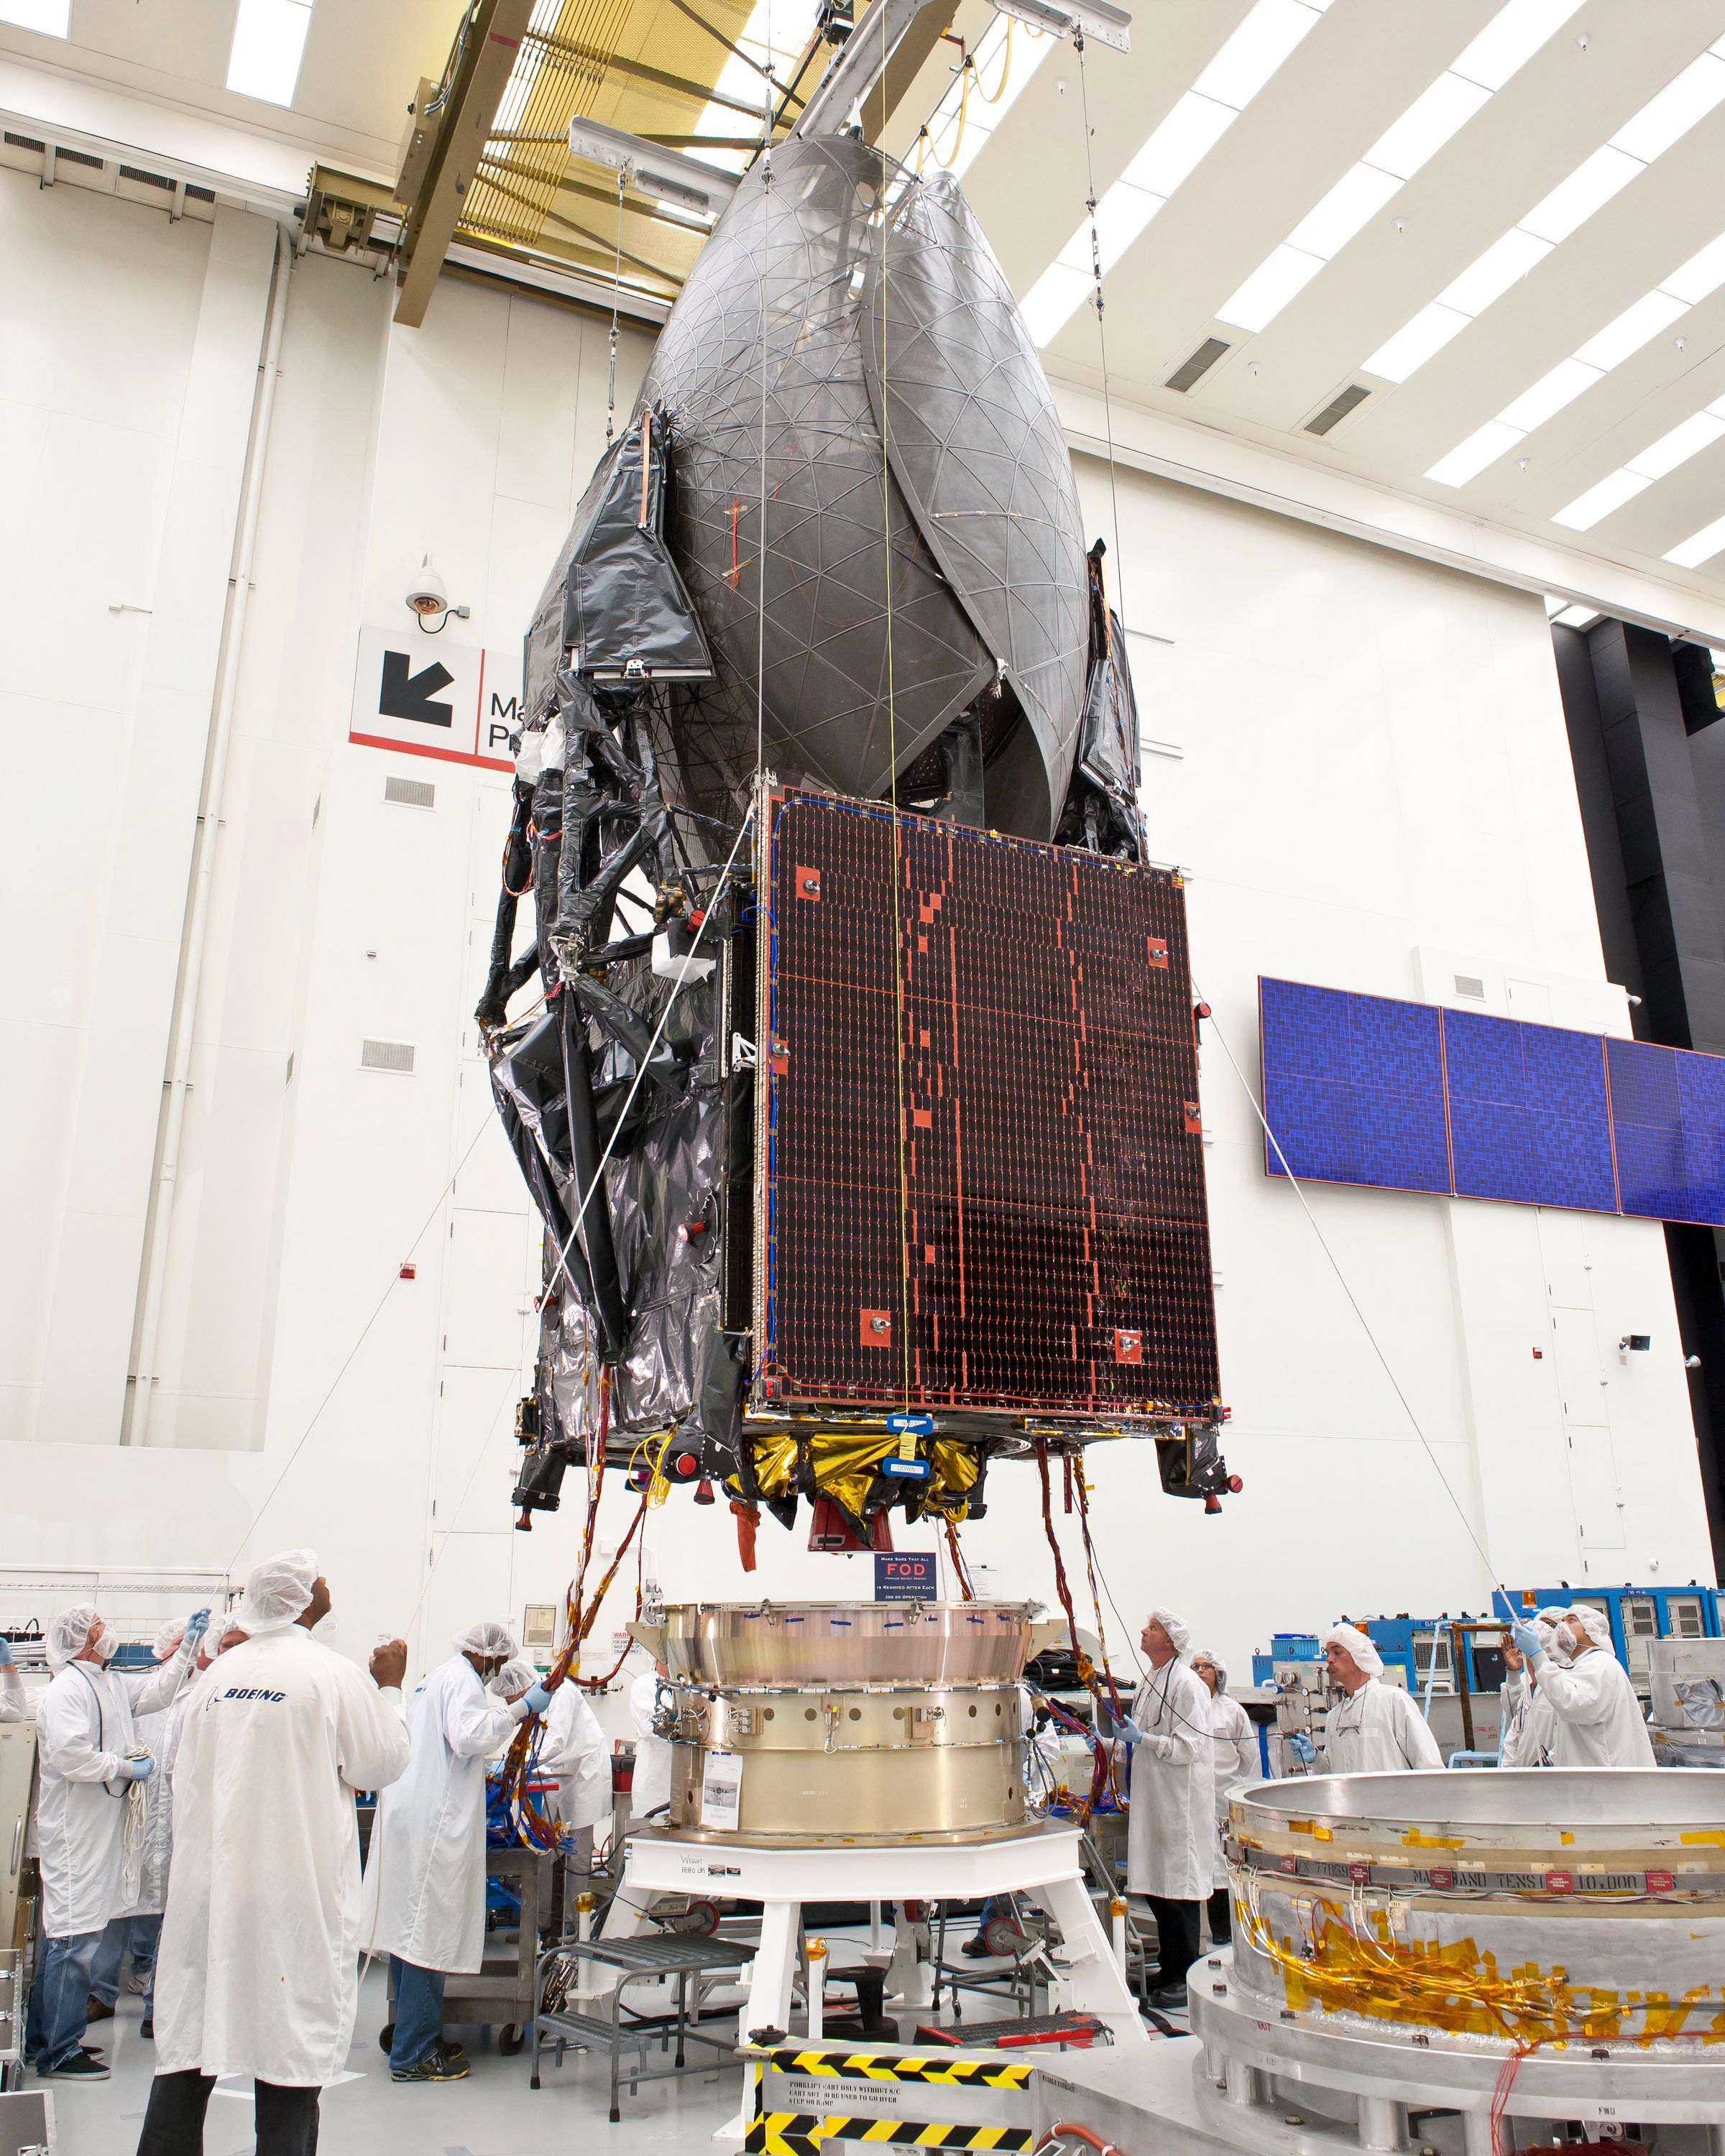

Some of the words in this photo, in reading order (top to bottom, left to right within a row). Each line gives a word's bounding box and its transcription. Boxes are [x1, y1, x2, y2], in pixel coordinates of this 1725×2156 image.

[887, 1563, 925, 1575] FOD
[224, 1688, 286, 1703] BOEING
[1496, 1874, 1545, 1889] TENSI
[1578, 1875, 1637, 1889] 10,000
